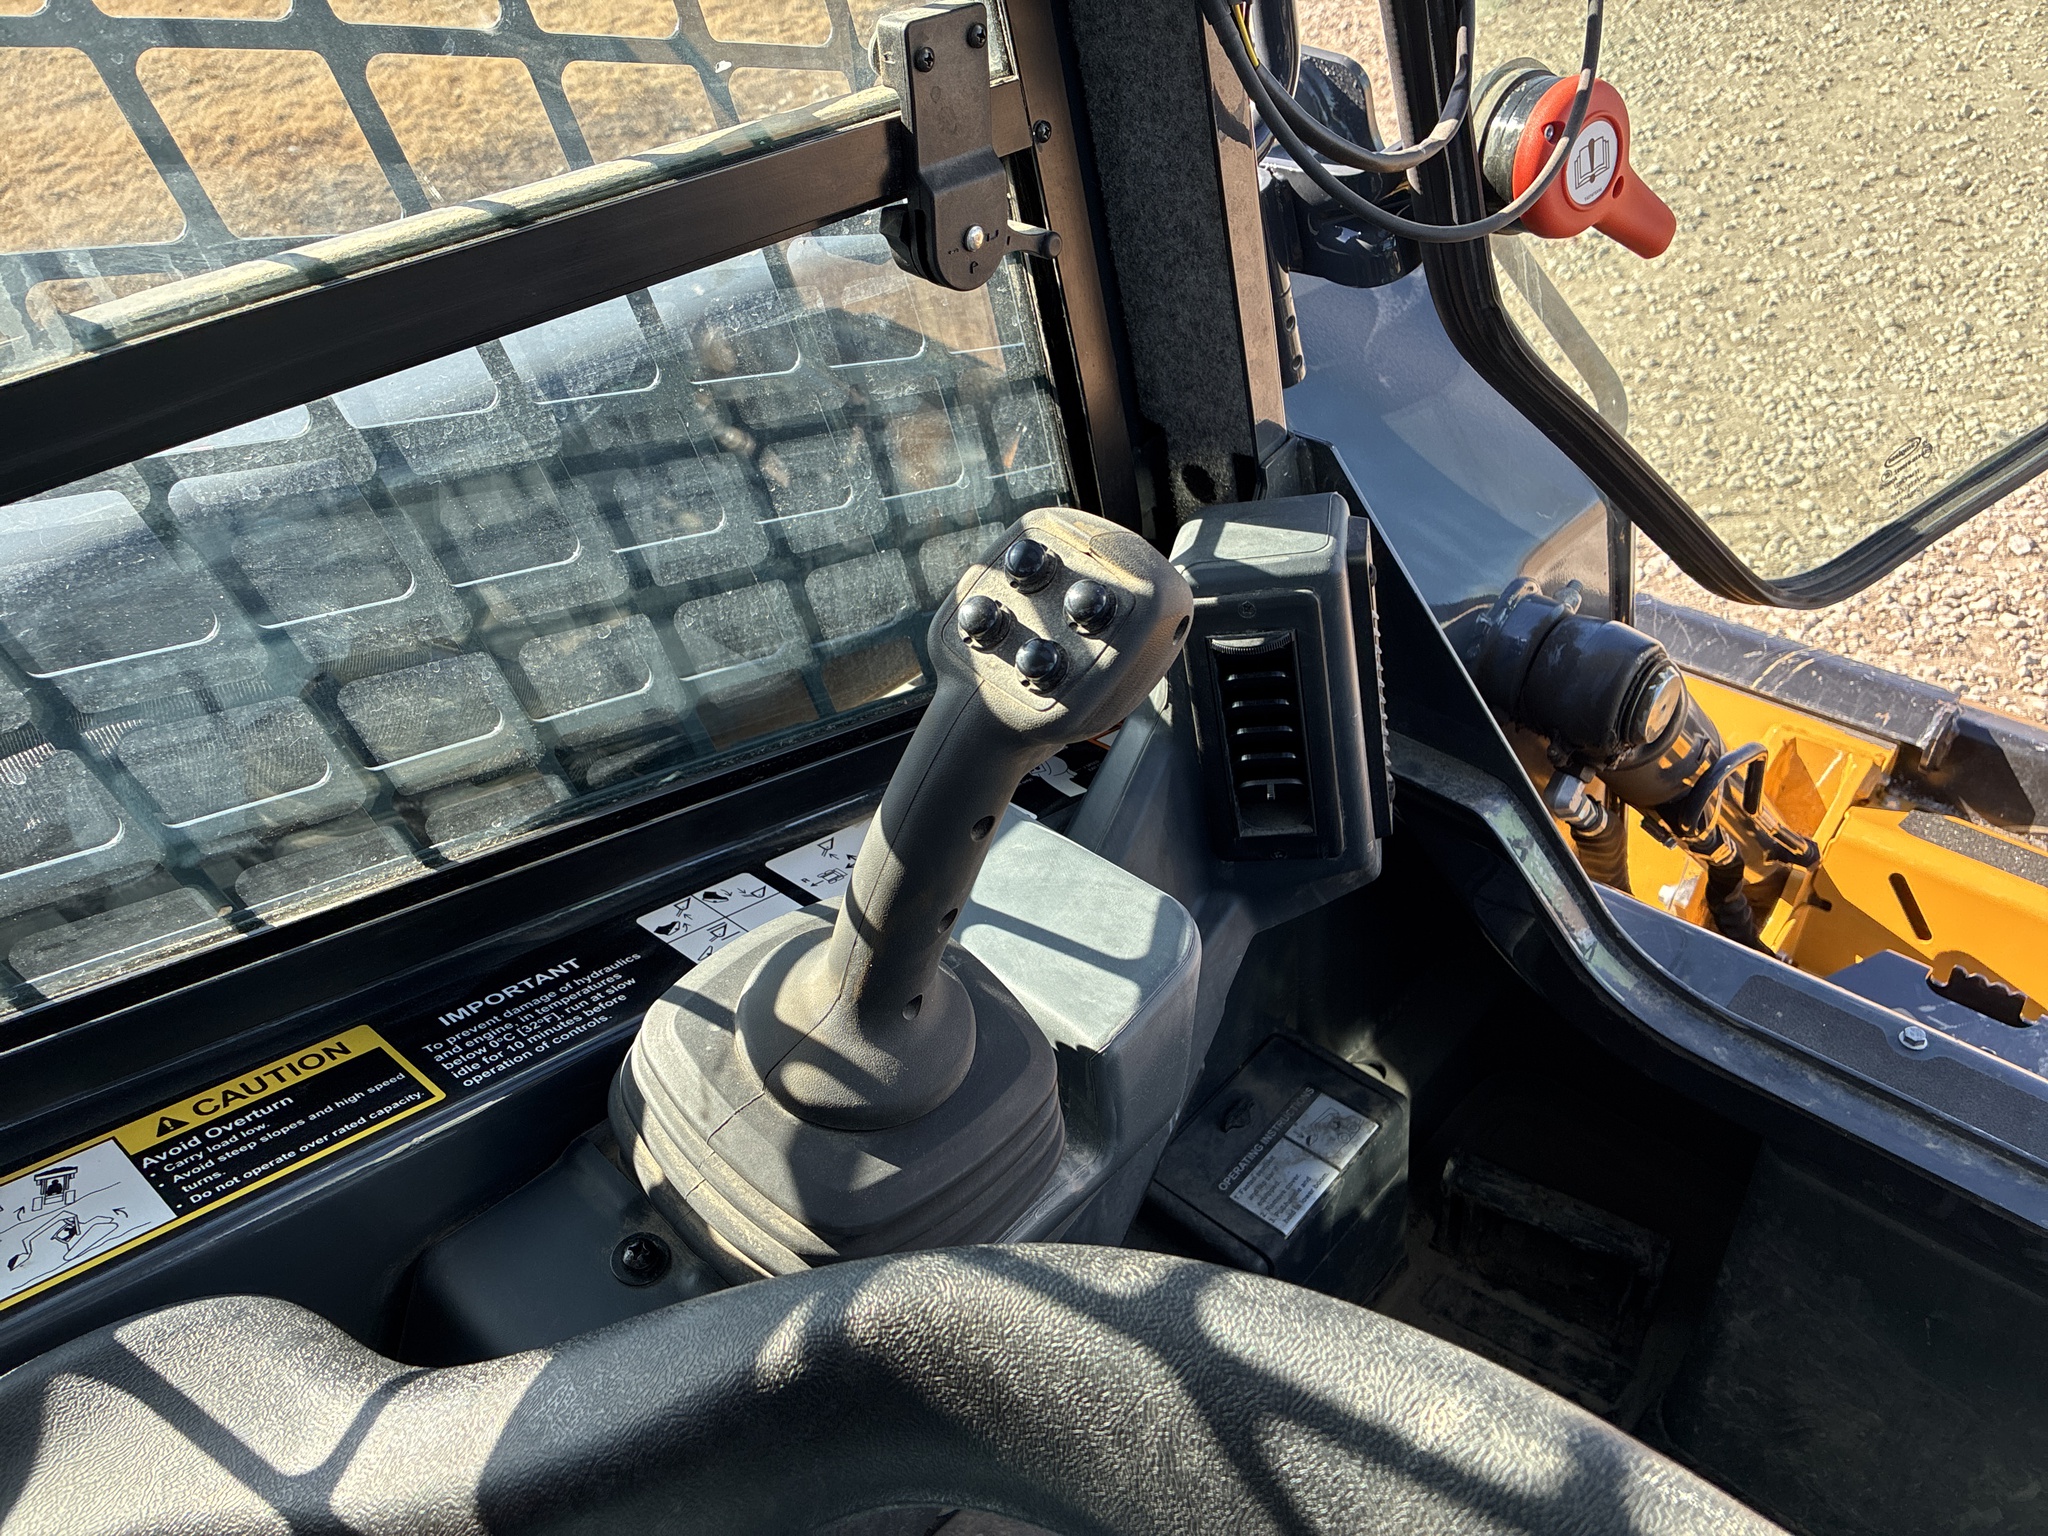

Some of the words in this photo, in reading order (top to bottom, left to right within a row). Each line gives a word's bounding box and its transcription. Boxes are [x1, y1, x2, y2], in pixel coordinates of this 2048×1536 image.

[422, 1043, 443, 1054] To
[446, 1015, 502, 1046] prevent
[503, 990, 558, 1018] damage
[559, 980, 574, 994] of
[573, 952, 642, 988] hydraulics
[434, 1044, 463, 1062] and
[465, 1021, 519, 1049] engine,
[519, 1011, 534, 1022] in
[534, 973, 623, 1015] temperatures
[438, 958, 581, 1026] IMPORTANT
[441, 1045, 488, 1071] below
[565, 1001, 589, 1014] run
[590, 992, 605, 1003] at
[606, 977, 636, 996] slow
[192, 1041, 352, 1116] CAUTION
[451, 1061, 482, 1079] idle
[483, 1050, 505, 1064] for
[506, 1041, 525, 1053] 10
[526, 1014, 582, 1044] minutes
[585, 993, 628, 1018] before
[463, 1050, 534, 1088] operation
[535, 1041, 551, 1053] of
[552, 1014, 613, 1045] controls.
[141, 1135, 202, 1168] Avoid
[205, 1096, 294, 1138] Overturn
[163, 1149, 204, 1173] Carry
[205, 1134, 238, 1154] load
[239, 1122, 271, 1139] low.
[173, 1158, 215, 1183] Avoid
[216, 1141, 257, 1164] steep
[259, 1118, 305, 1143] slopes
[307, 1104, 333, 1121] and
[335, 1091, 364, 1108] high
[366, 1072, 405, 1094] speed
[189, 1189, 214, 1204] Do
[215, 1176, 241, 1193] not
[242, 1151, 296, 1180] operate
[299, 1135, 328, 1153] over
[331, 1116, 367, 1138] rated
[368, 1092, 425, 1121] capacity.
[1218, 1143, 1264, 1191] OPERATING
[1263, 1087, 1314, 1144] INSTRUCTIONS
[181, 1171, 226, 1192] turns.
